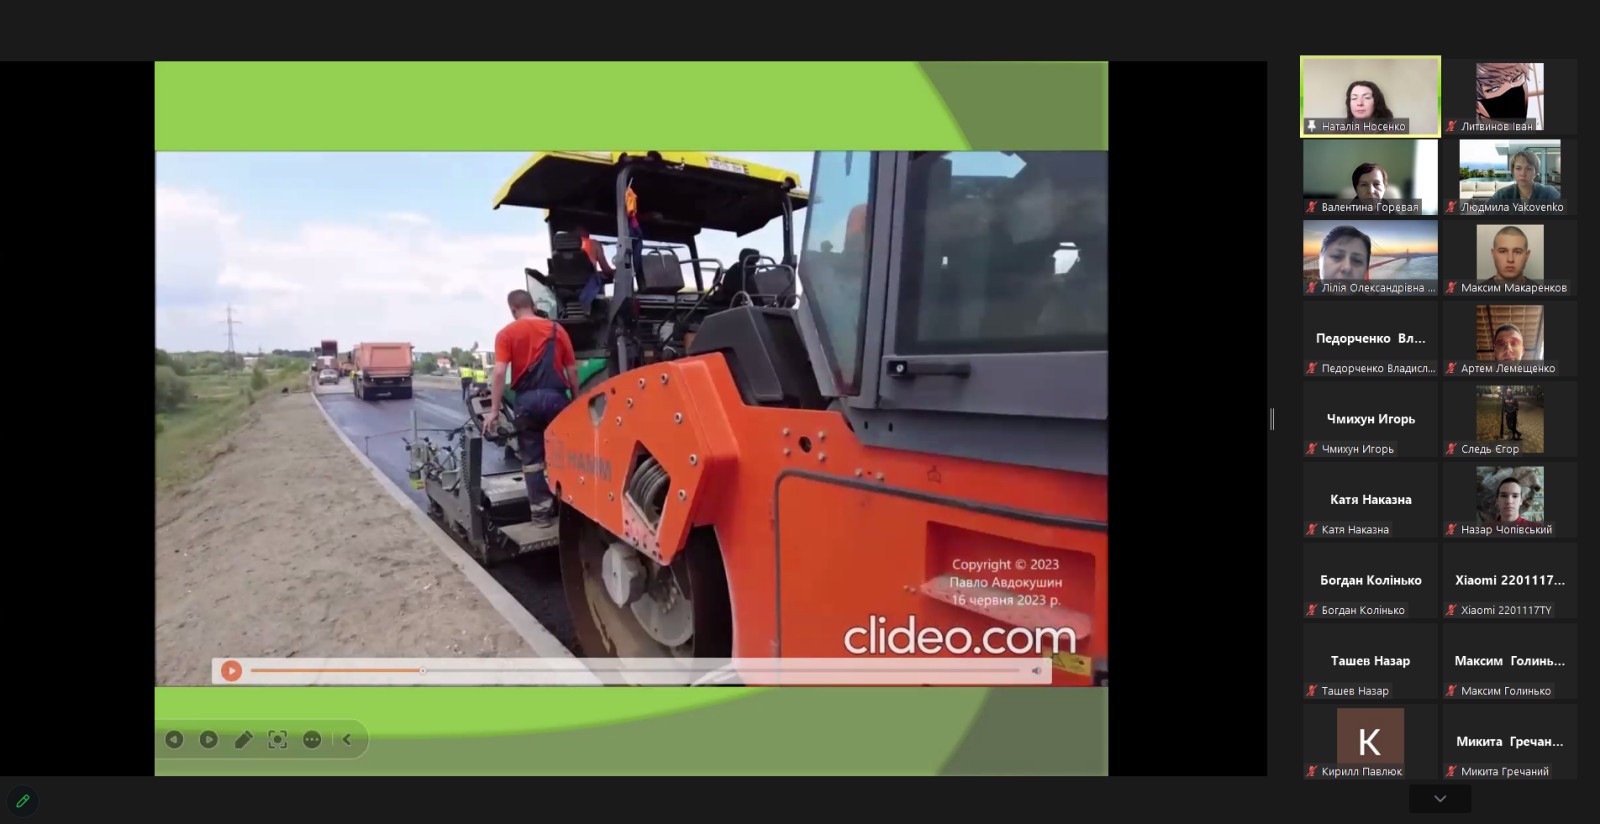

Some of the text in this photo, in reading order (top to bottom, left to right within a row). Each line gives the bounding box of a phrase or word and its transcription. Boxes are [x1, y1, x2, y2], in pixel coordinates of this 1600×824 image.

[1322, 122, 1406, 131] Наталія Носенко
[1461, 122, 1533, 132] Литвинов Іван
[1322, 202, 1419, 214] Валентина Горевая
[1461, 202, 1564, 214] Людмила Yakovenko
[1322, 283, 1347, 293] Лілія
[1350, 283, 1425, 295] Олександрівна
[1462, 283, 1567, 295] Максим Макаренков
[1316, 333, 1391, 347] Педорченко
[1322, 364, 1384, 376] Педорченко
[1461, 364, 1556, 376] Артем Лемещенко
[1327, 413, 1416, 427] Чмихун Игорь
[1322, 444, 1394, 456] Чмихун Игорь
[1462, 444, 1519, 456] Следь Єгор
[1331, 494, 1412, 506] Катя Наказна
[1322, 525, 1389, 535] Катя Наказна
[1462, 524, 1552, 537] Назар Чопівський
[1321, 574, 1422, 589] Богдан Колінько
[1455, 574, 1497, 587] Xiaomi
[1322, 605, 1405, 617] Богдан Колінько
[1461, 605, 1551, 616] Xiaomi 2201117TY
[1331, 655, 1410, 669] Ташев Назар
[1455, 655, 1503, 667] Максим
[1322, 686, 1389, 699] Ташев Назар
[1462, 686, 1551, 696] Максим Голинько
[1457, 736, 1503, 748] Микита
[1322, 766, 1402, 779] Кирилл Павлюк
[1462, 766, 1549, 779] Микита Гречаний
